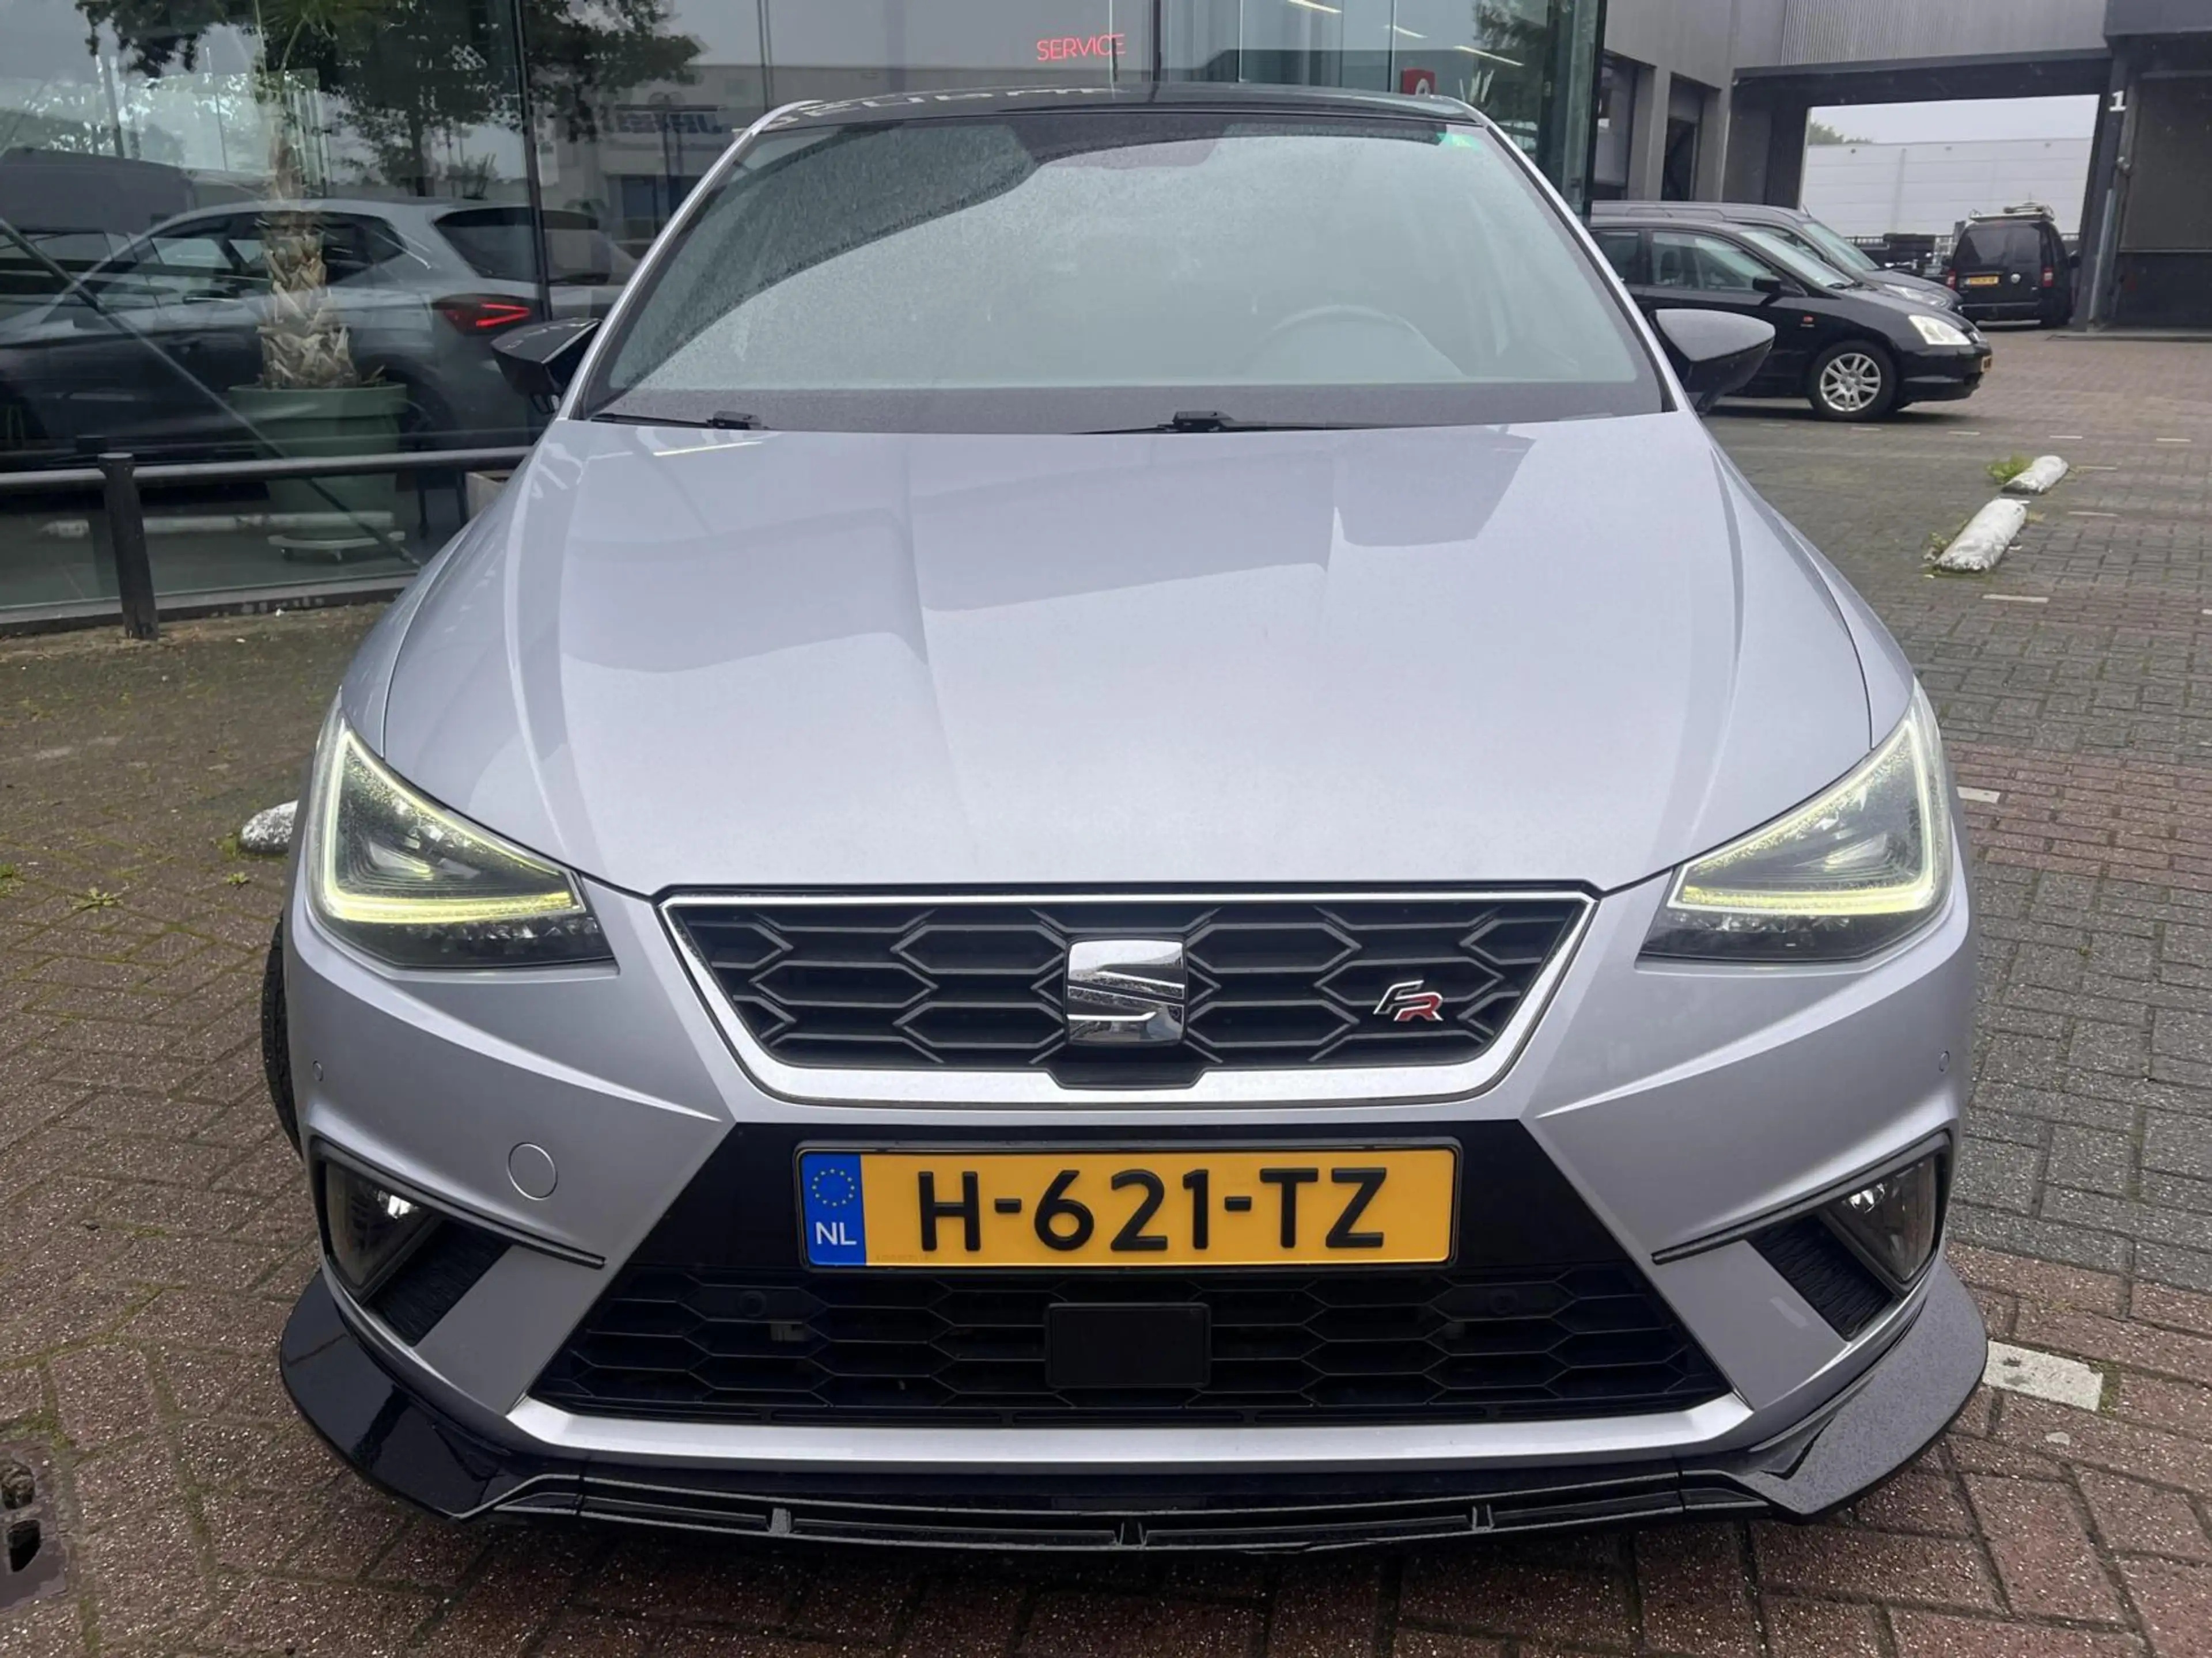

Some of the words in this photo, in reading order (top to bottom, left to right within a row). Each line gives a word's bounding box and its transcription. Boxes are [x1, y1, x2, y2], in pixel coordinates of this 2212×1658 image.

[1037, 33, 1126, 60] SERVICE
[2109, 90, 2126, 112] 1
[1373, 980, 1444, 1022] FR
[918, 1168, 1387, 1251] H-621-TZ
[816, 1221, 857, 1246] NL
